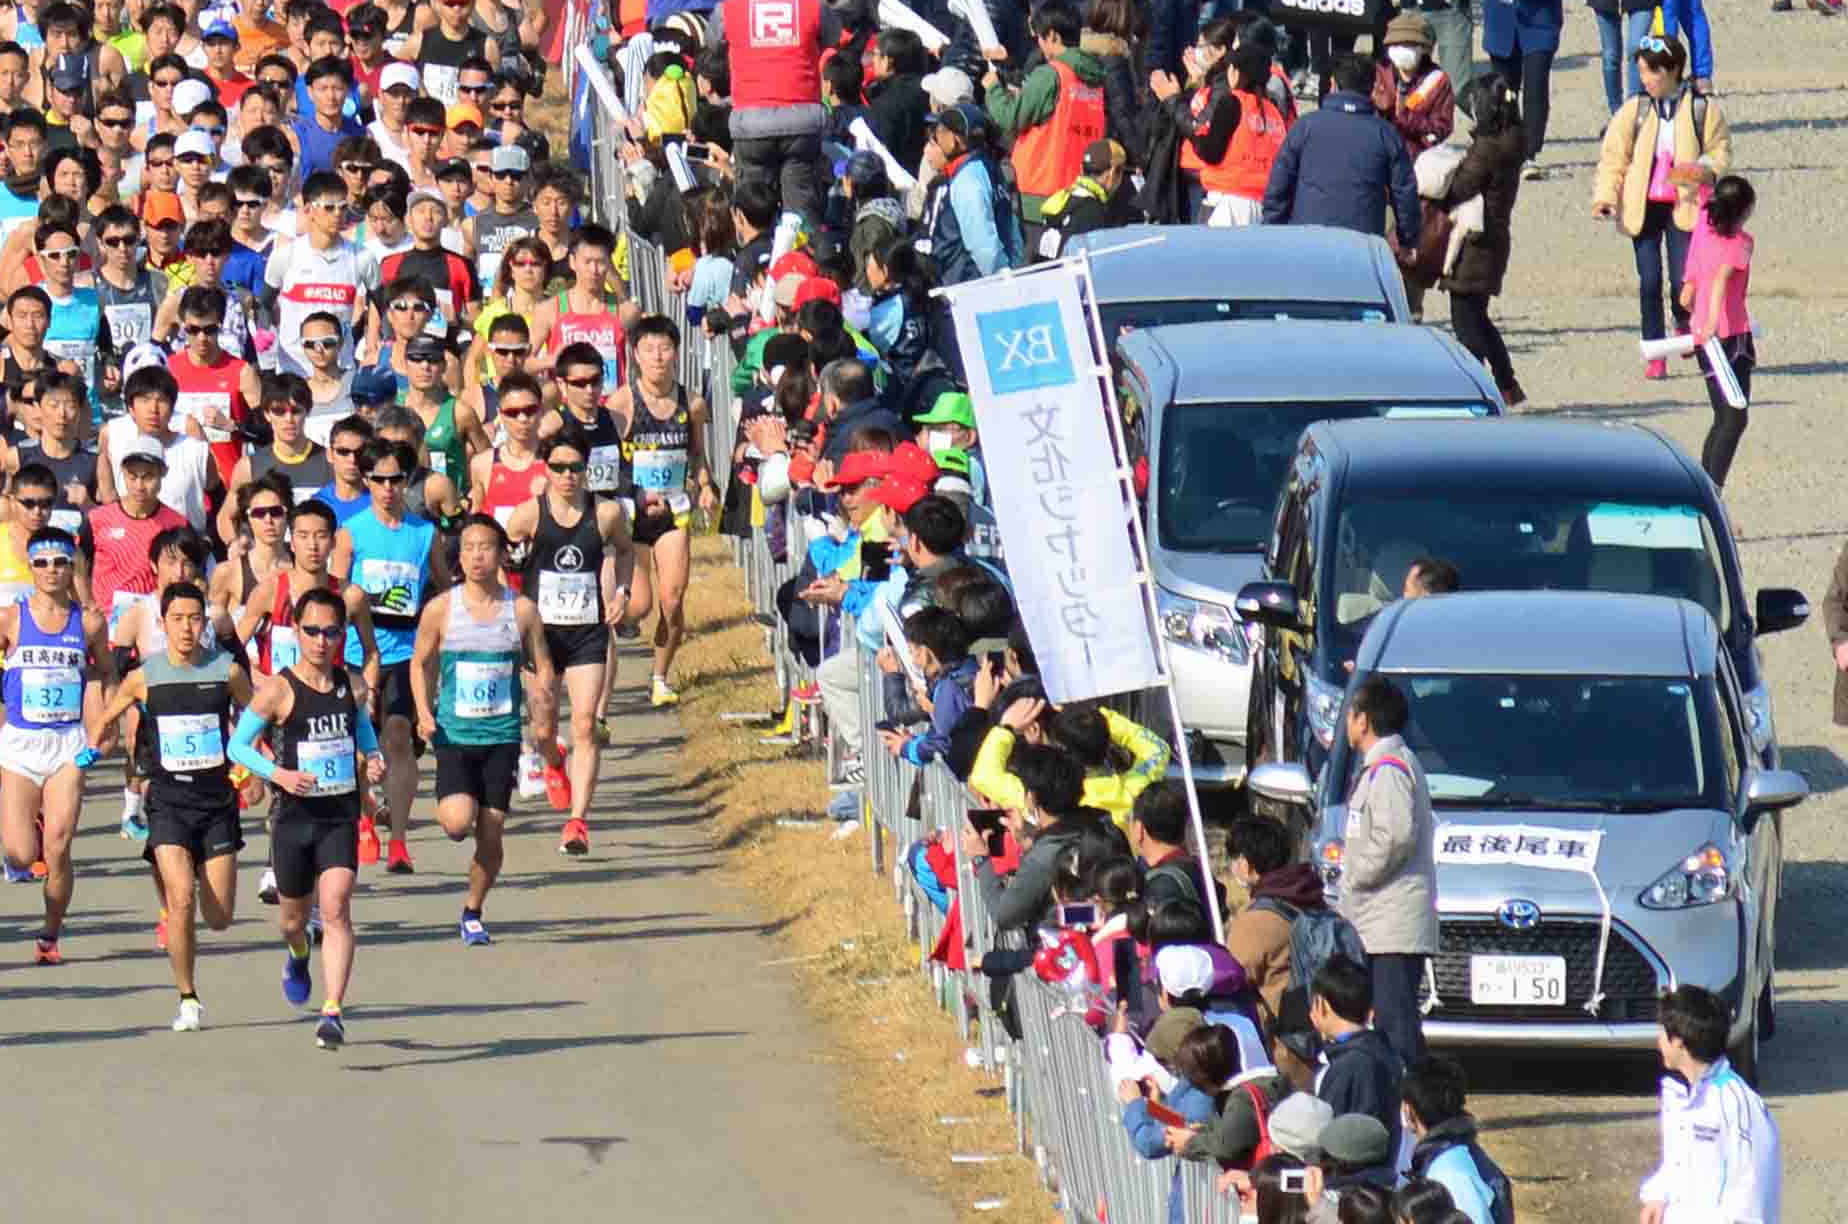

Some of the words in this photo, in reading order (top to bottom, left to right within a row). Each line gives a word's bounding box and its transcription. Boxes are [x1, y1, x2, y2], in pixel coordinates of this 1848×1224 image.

[110, 320, 145, 341] 307
[39, 687, 64, 707] 32
[473, 681, 497, 701] 68
[185, 735, 196, 755] 5
[324, 759, 336, 779] 8
[1442, 834, 1589, 859] 最後尾車
